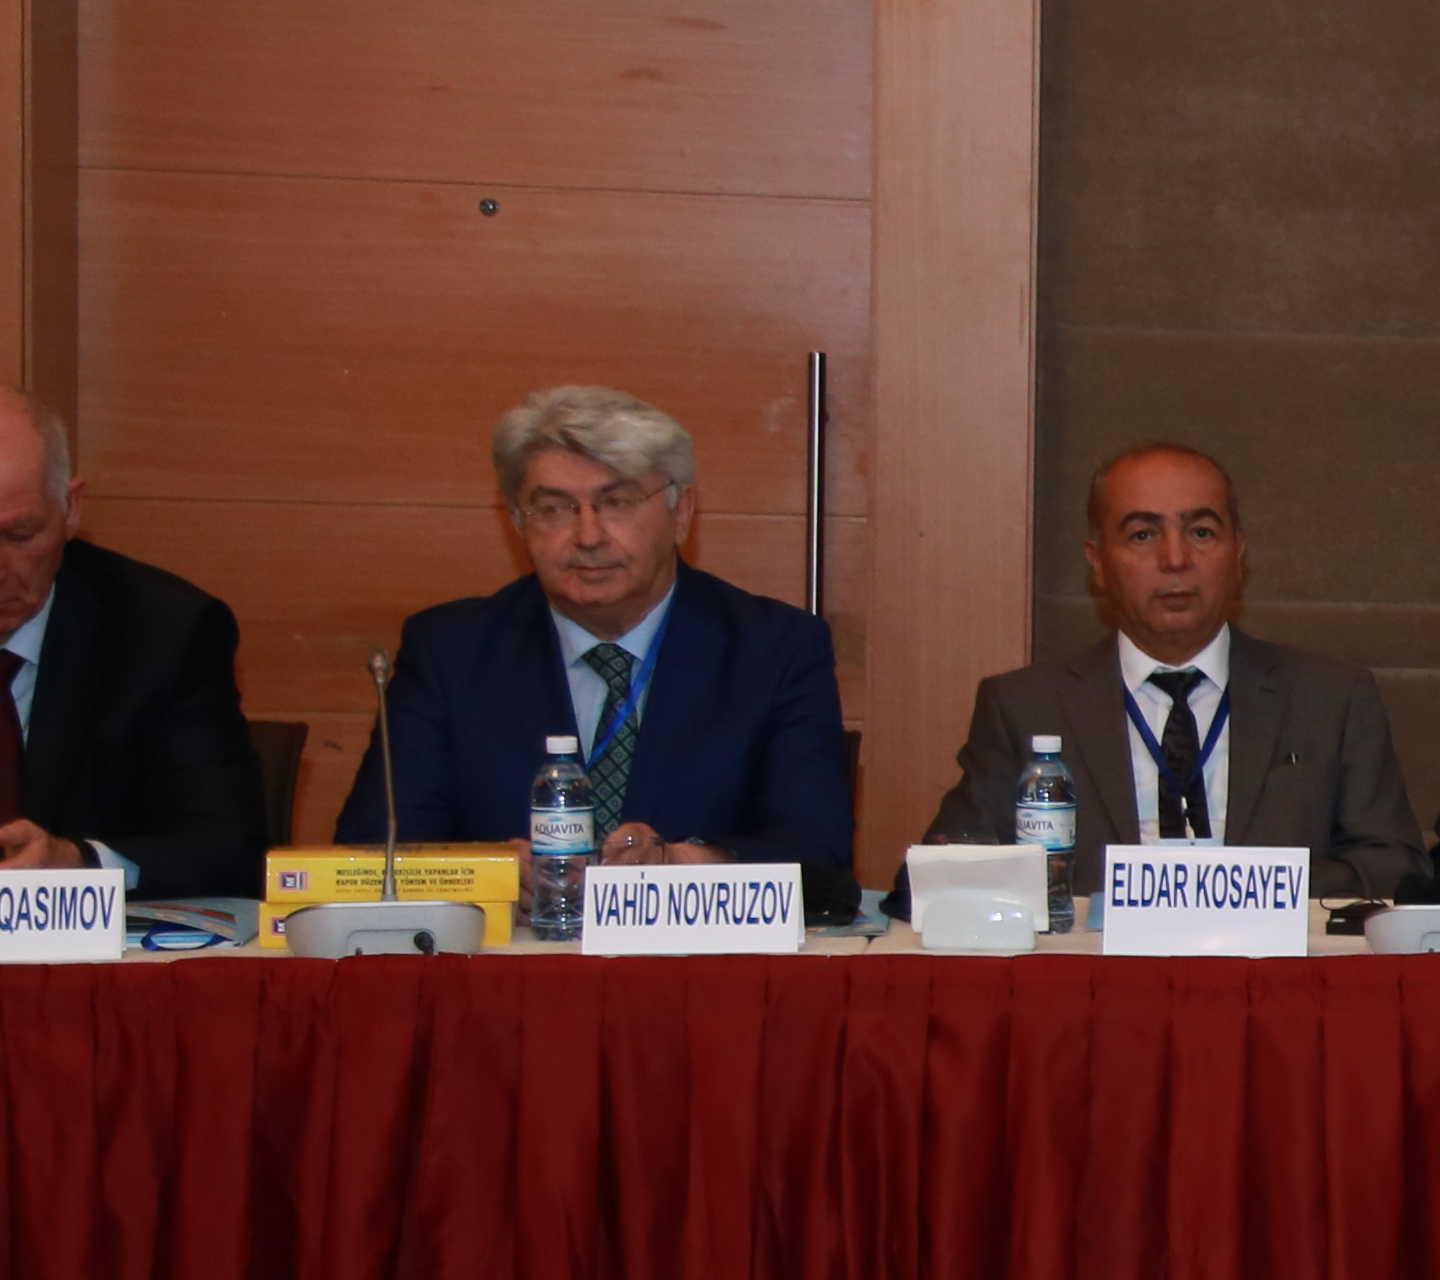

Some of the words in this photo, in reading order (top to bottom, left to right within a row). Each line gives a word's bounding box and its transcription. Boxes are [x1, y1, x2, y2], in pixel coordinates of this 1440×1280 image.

[534, 823, 584, 834] AQUAVITA
[594, 873, 659, 926] VAHİD
[668, 882, 792, 925] NOVRUZOV
[1112, 863, 1187, 907] ELDAR
[1196, 864, 1302, 909] KOSAYEV
[0, 886, 115, 933] QASIMOV
